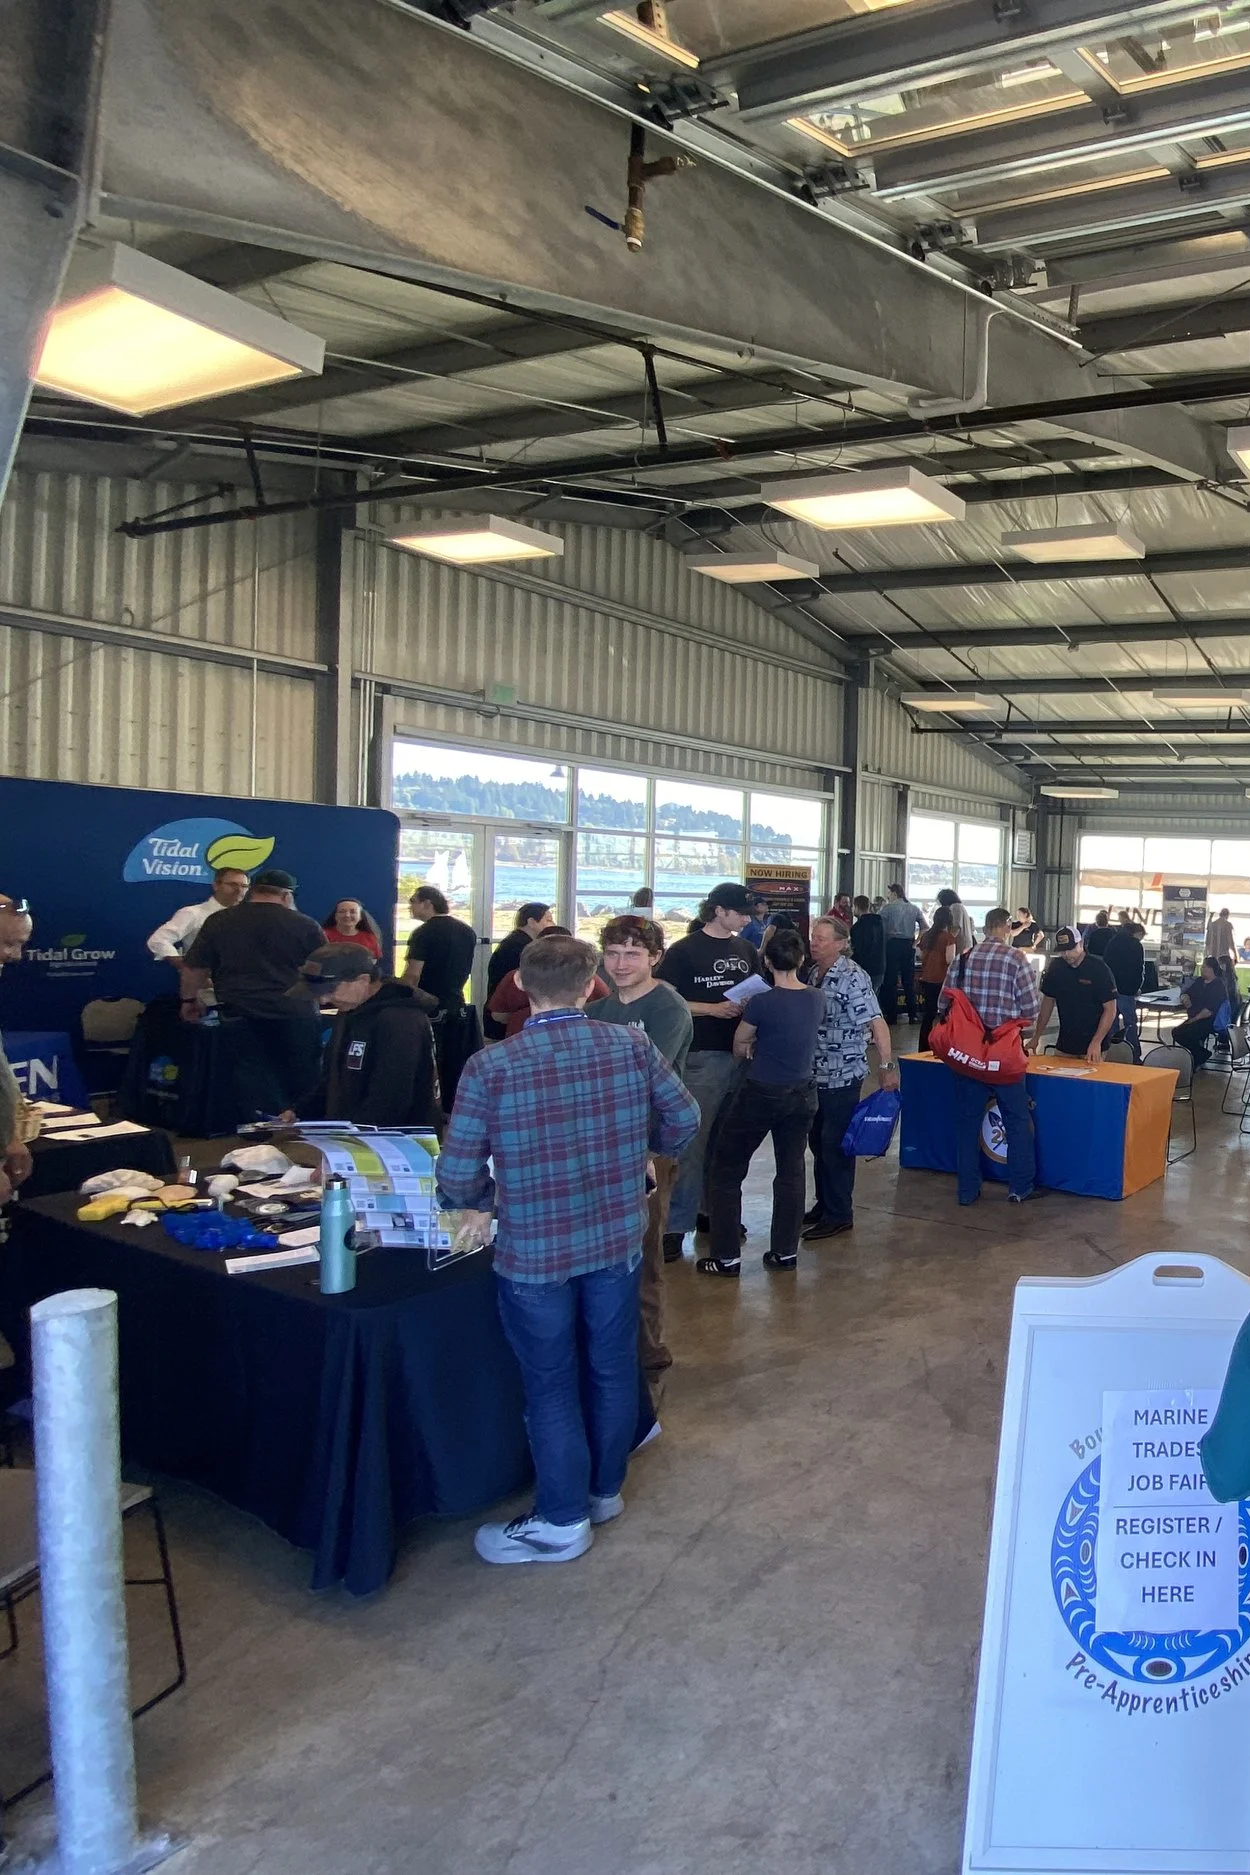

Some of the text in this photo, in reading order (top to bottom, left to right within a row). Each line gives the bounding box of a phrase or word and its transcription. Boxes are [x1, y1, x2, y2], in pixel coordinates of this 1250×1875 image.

[149, 837, 200, 858] Tidal
[142, 858, 202, 876] Vision
[750, 868, 808, 879] NOW HIRING
[27, 947, 116, 961] Tidal Grow
[1133, 1408, 1208, 1426] MARINE
[1127, 1473, 1164, 1492] JOB
[1115, 1517, 1210, 1536] REGISTER
[1120, 1551, 1216, 1570] CHECK IN
[1141, 1585, 1195, 1604] HERE
